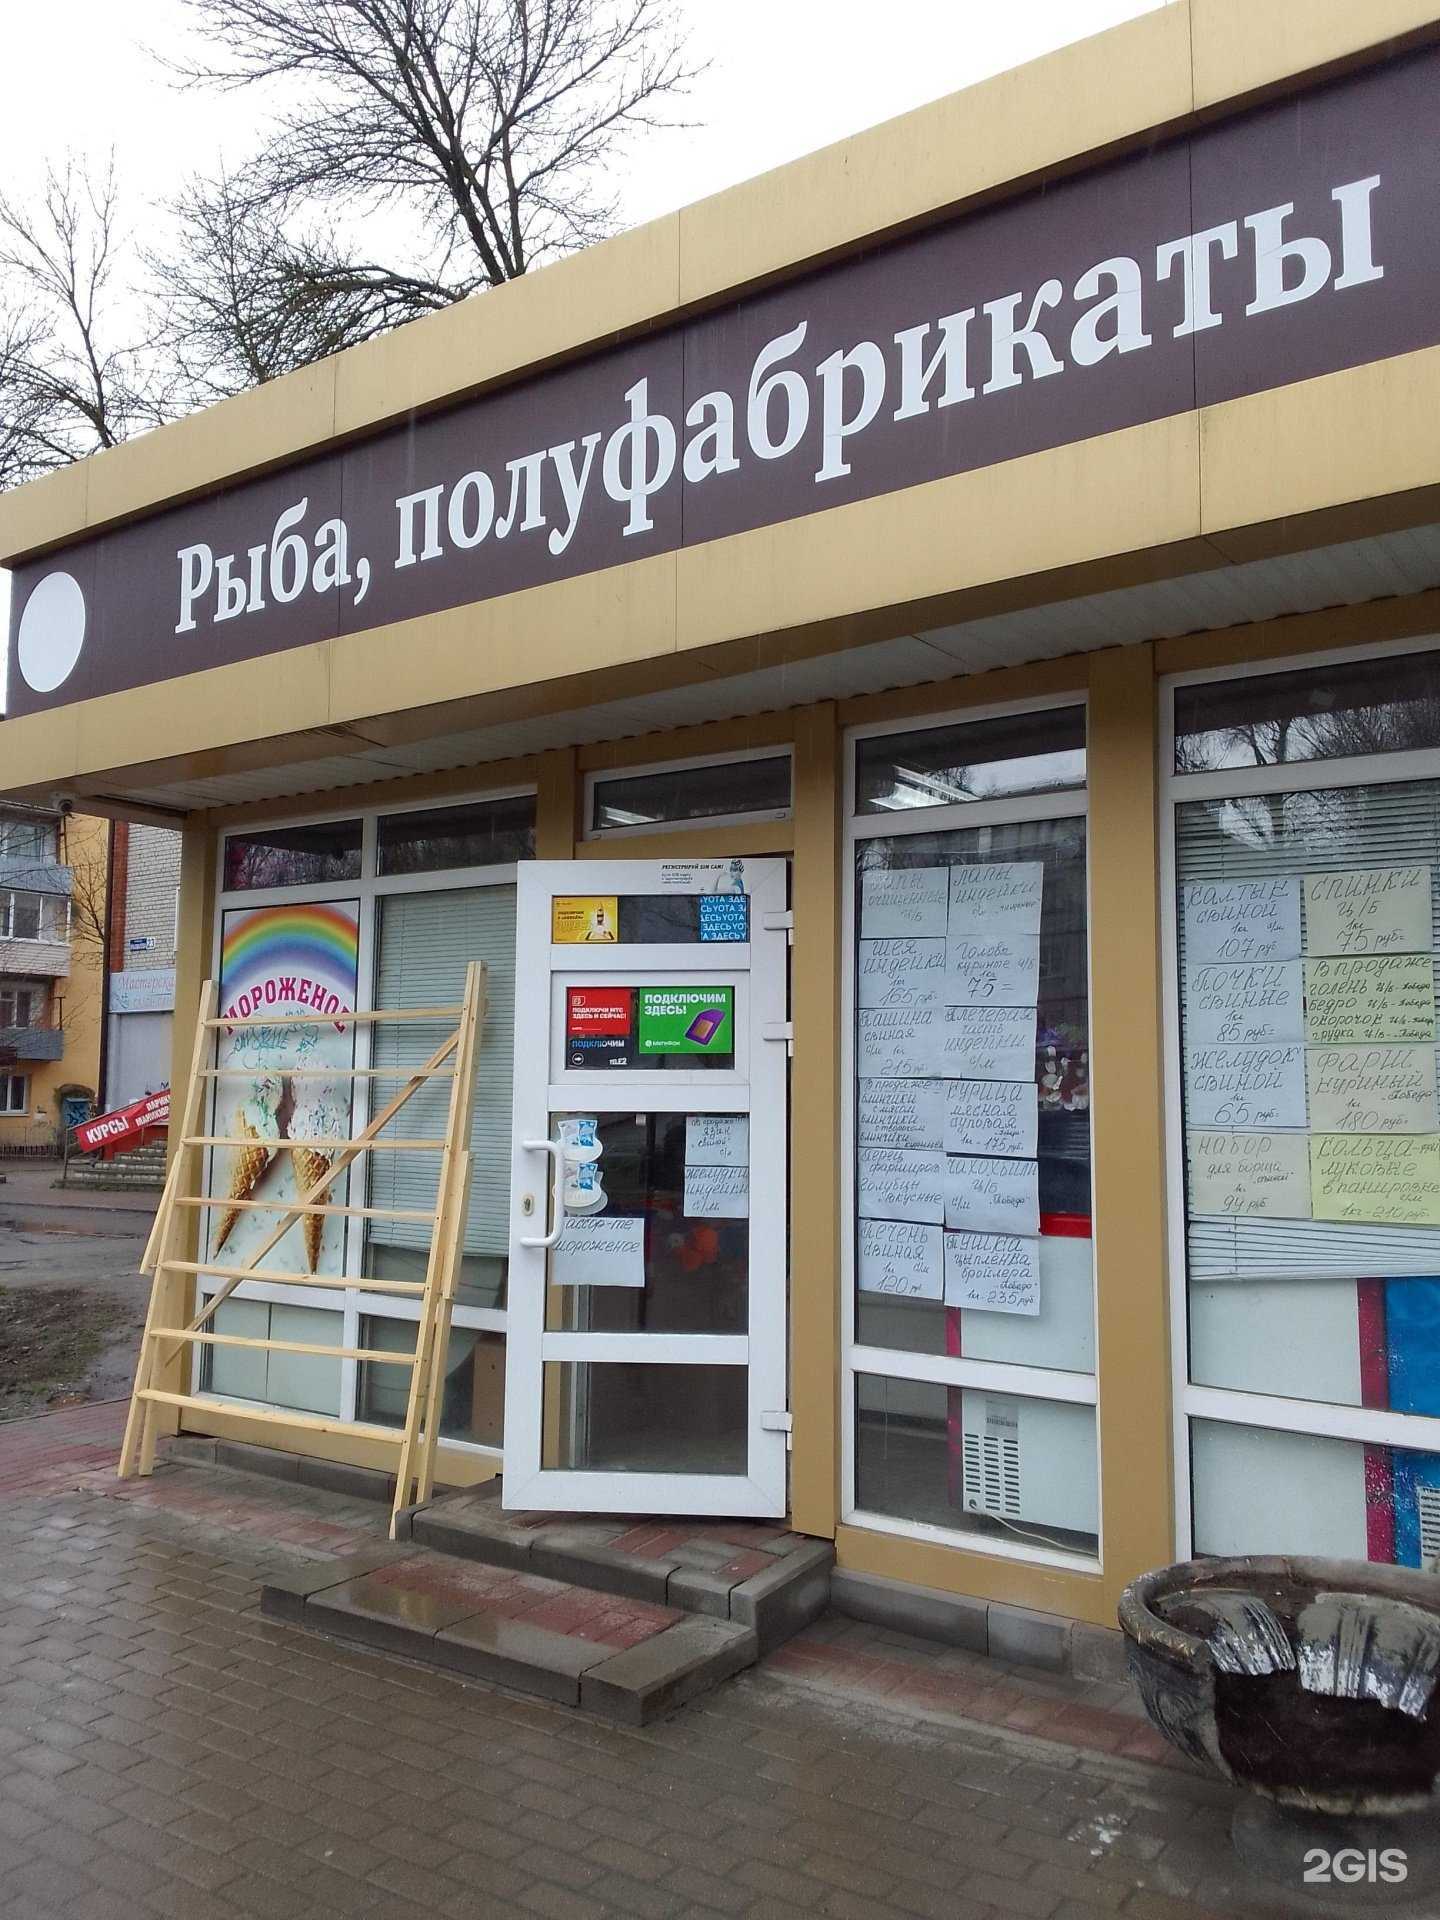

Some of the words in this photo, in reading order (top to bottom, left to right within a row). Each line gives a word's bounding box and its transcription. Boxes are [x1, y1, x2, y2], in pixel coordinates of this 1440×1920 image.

[175, 496, 370, 634] Рыба,
[393, 173, 1385, 569] полуфабрикаты
[703, 895, 725, 903] YOTA
[713, 904, 735, 912] YOTA
[722, 913, 744, 921] YOTA
[703, 923, 731, 931] ЗДЕСЬ
[711, 932, 740, 940] ЗДЕСЬ
[644, 993, 726, 1004] ПОДКЛЮЧИМ
[644, 1005, 687, 1016] ЗДЕСЬ!
[572, 1040, 625, 1048] ПОДКЛЮЧИМ
[1215, 1103, 1252, 1123] 65
[86, 1116, 129, 1144] КУРСЫ
